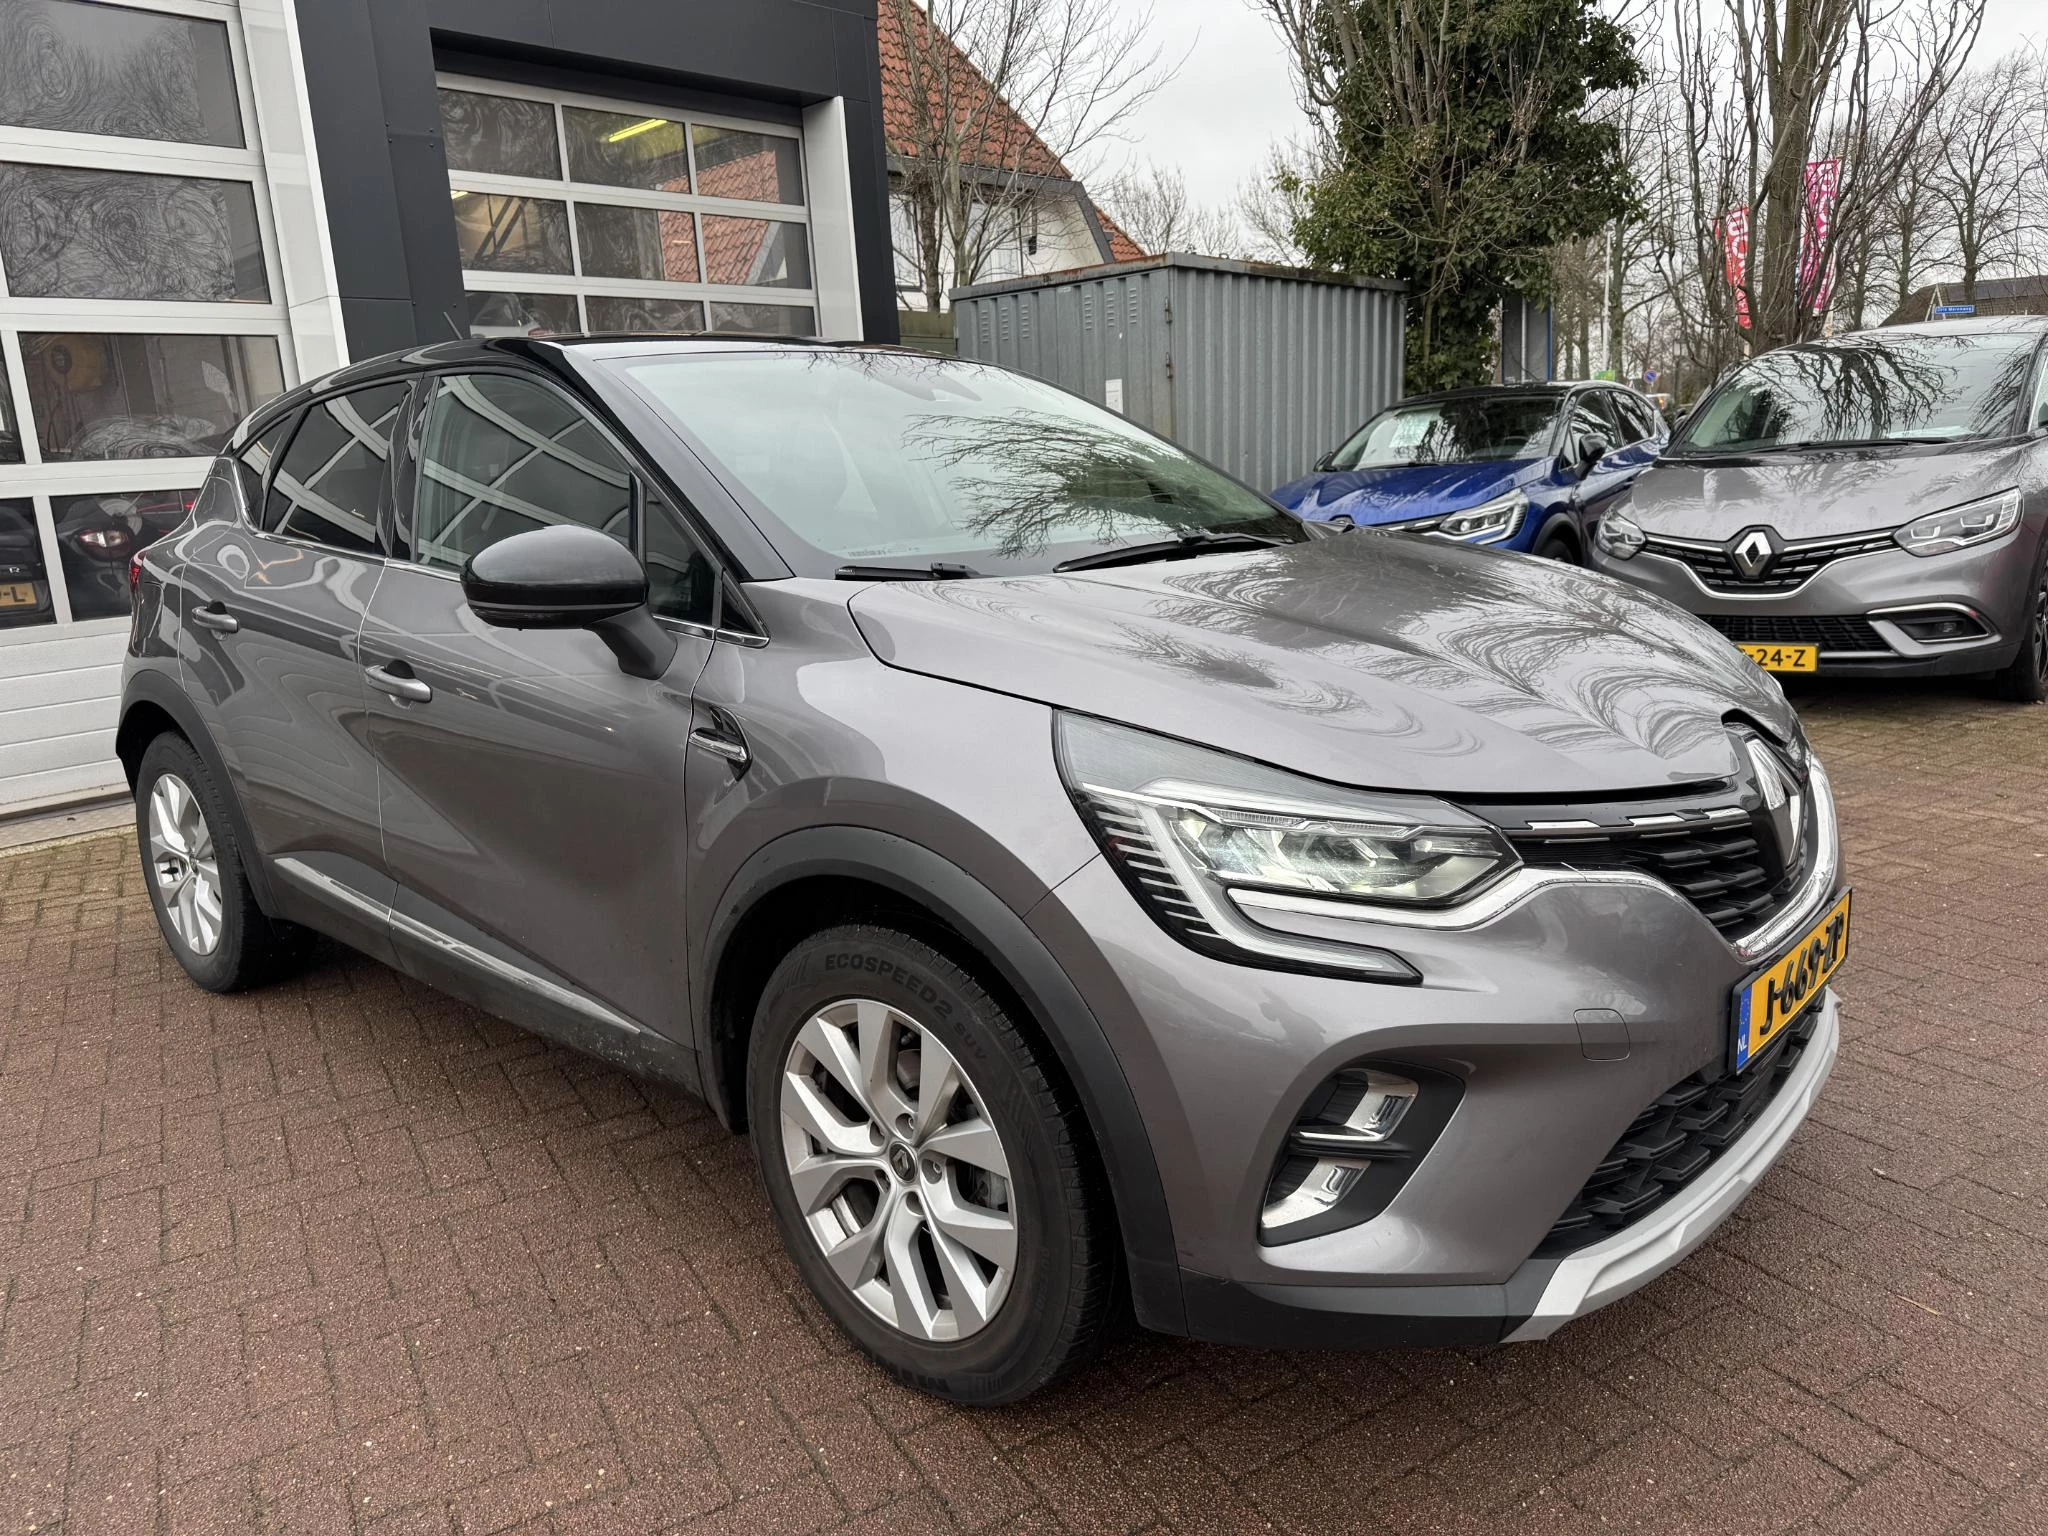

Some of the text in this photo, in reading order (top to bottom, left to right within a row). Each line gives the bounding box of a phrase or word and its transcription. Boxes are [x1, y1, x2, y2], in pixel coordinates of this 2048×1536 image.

[1741, 648, 1806, 667] -24-Z
[1759, 911, 1845, 1036] J-669-ZP
[1737, 1034, 1748, 1055] NL
